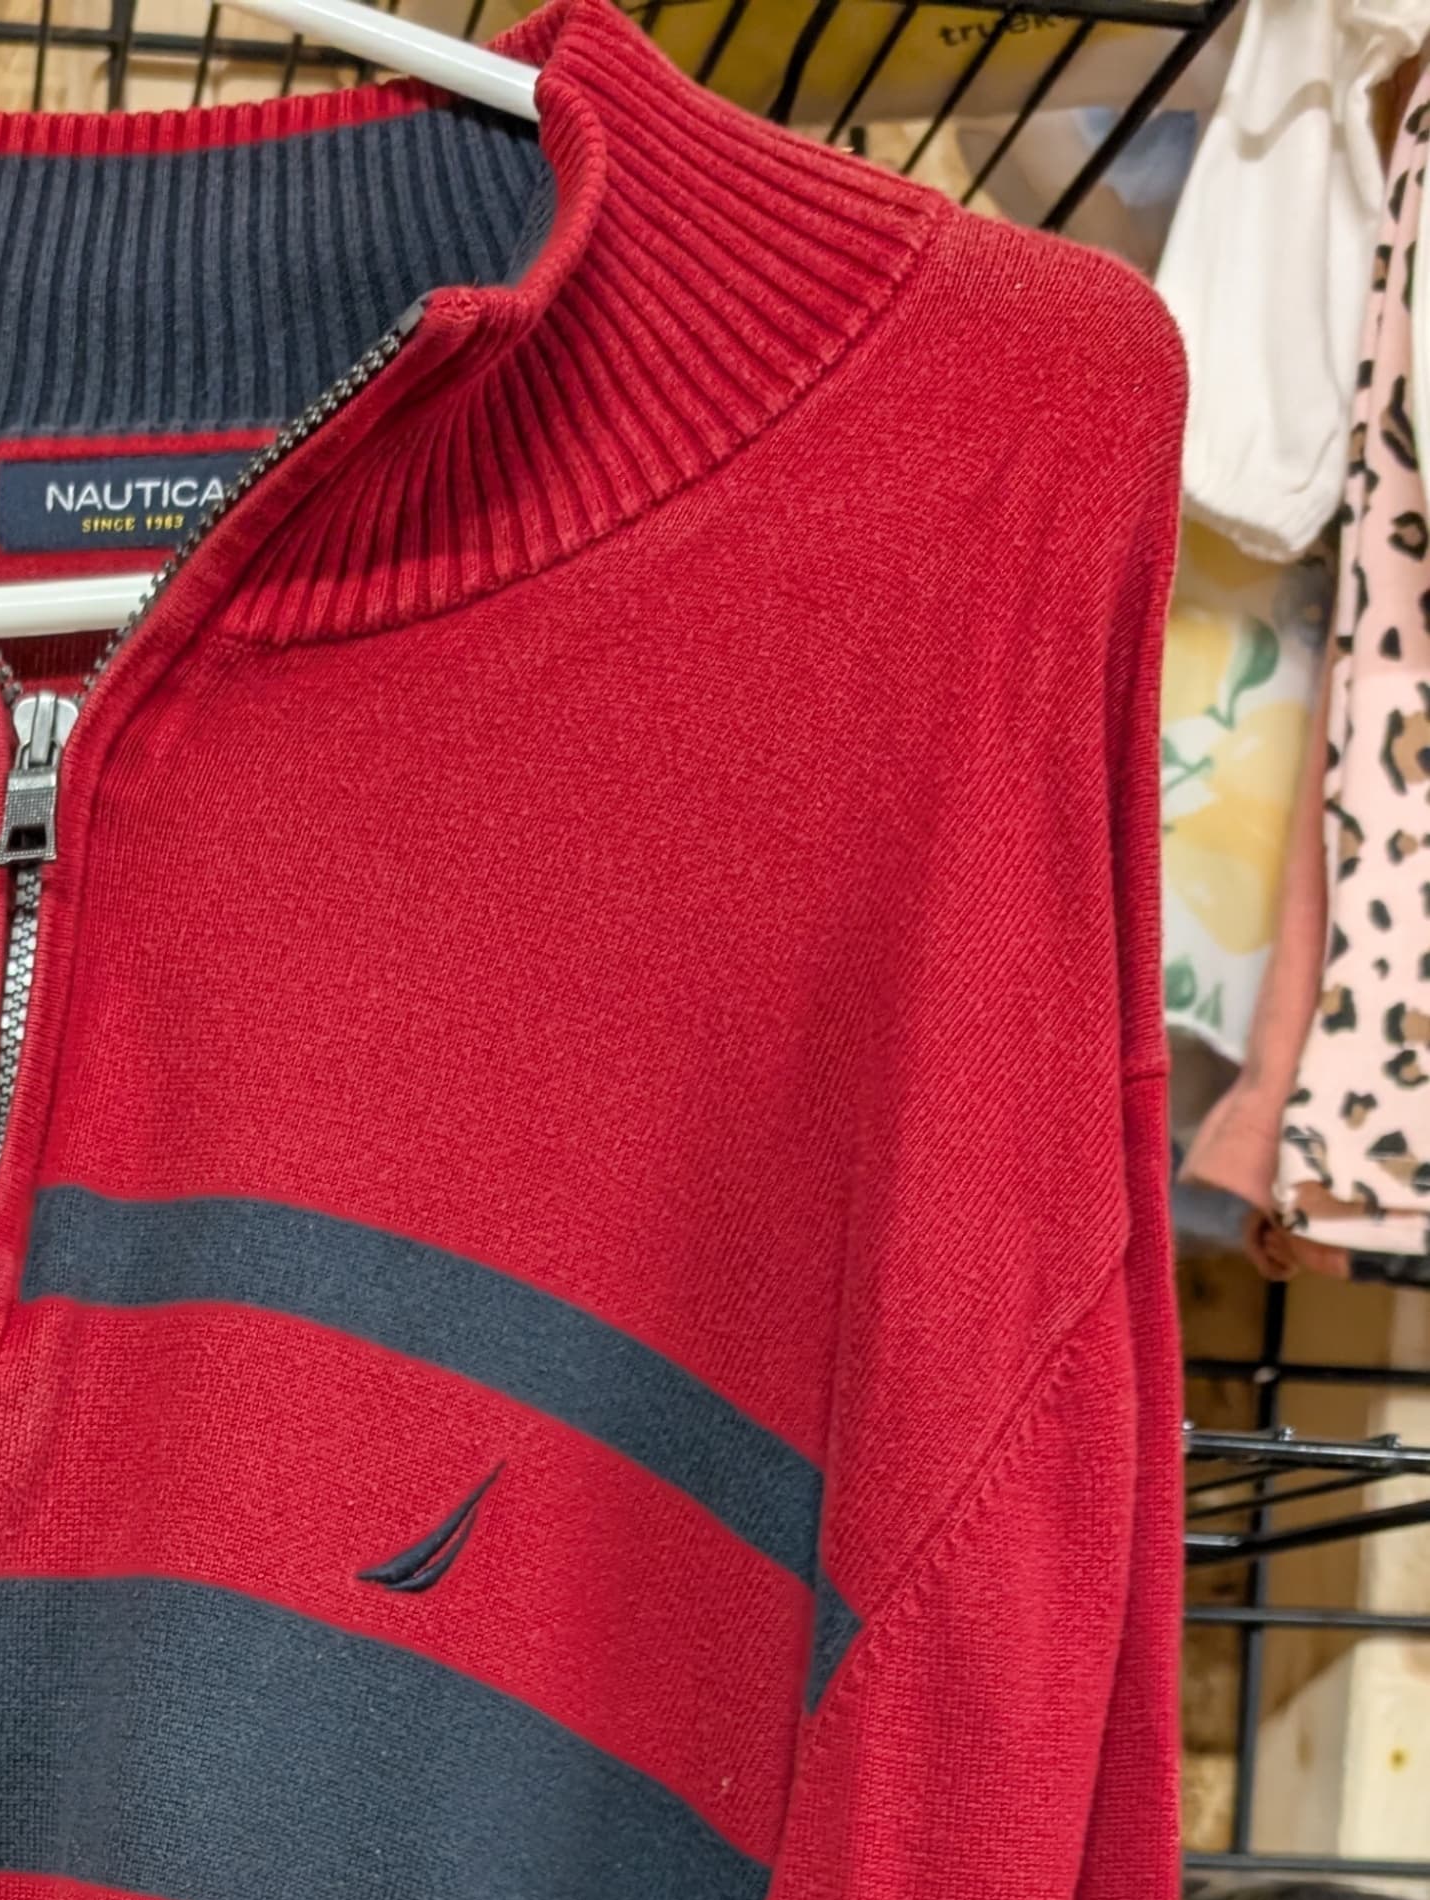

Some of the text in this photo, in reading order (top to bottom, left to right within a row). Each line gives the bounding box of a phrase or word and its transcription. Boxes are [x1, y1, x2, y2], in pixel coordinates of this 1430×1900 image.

[45, 476, 225, 512] NAUTICA
[81, 513, 185, 533] SINCE 1983
